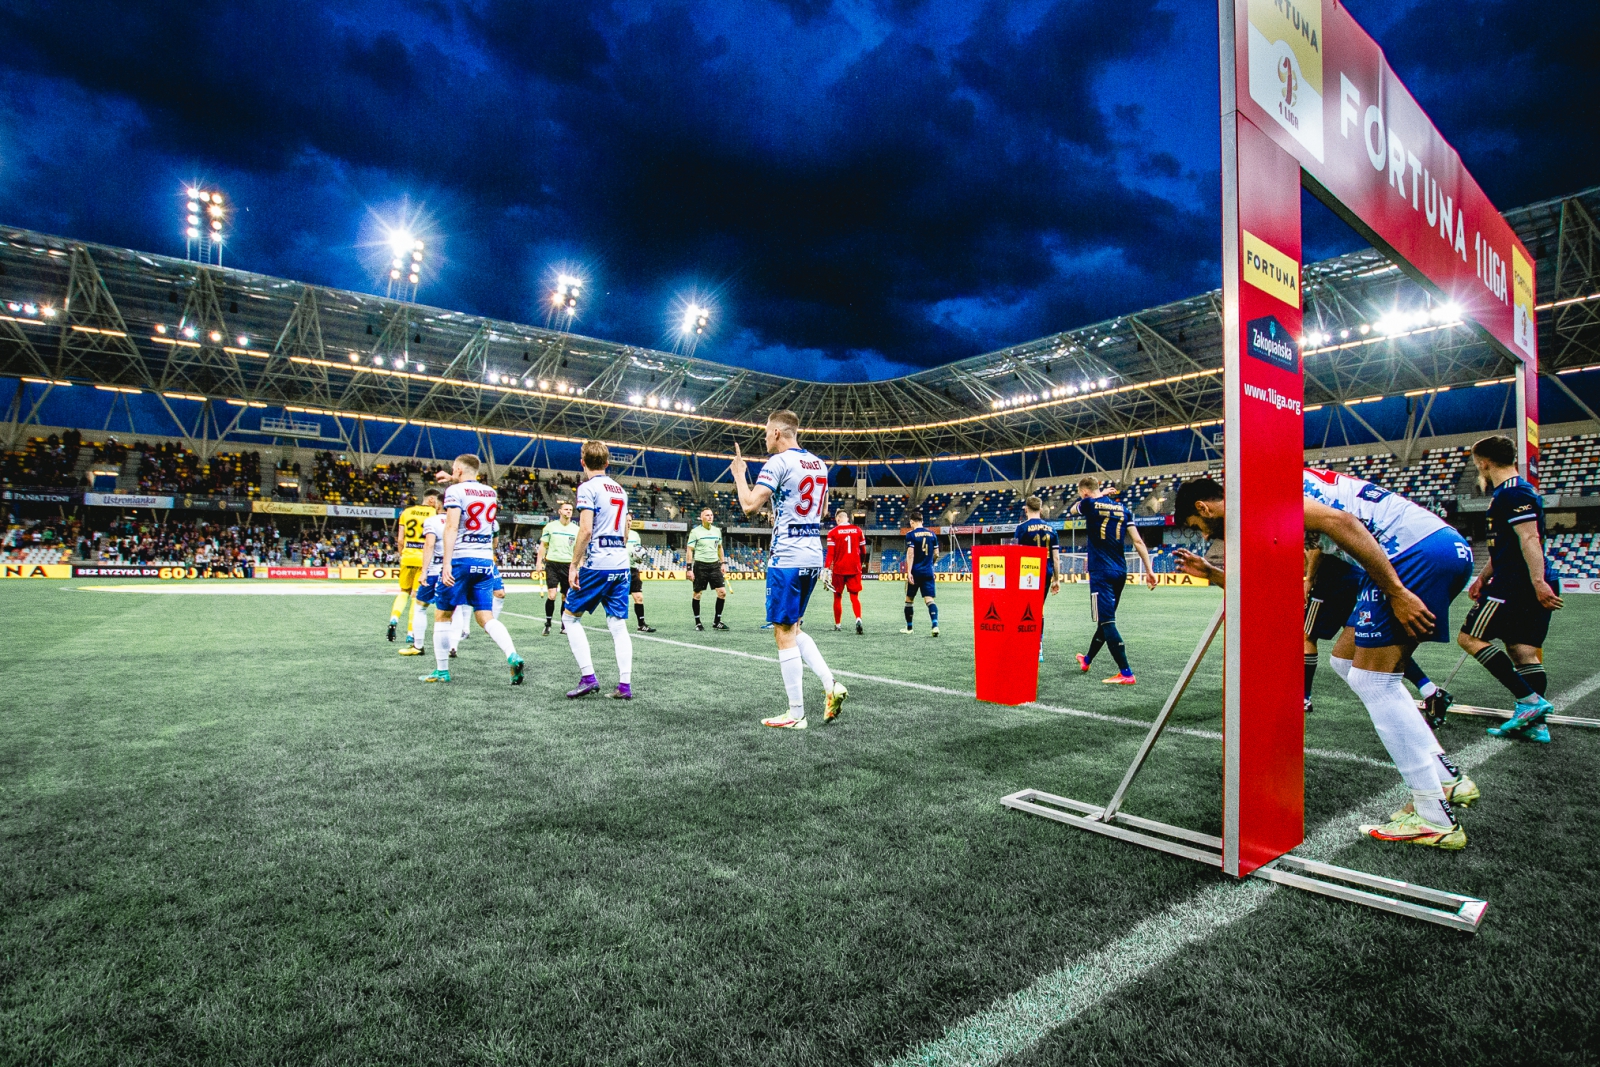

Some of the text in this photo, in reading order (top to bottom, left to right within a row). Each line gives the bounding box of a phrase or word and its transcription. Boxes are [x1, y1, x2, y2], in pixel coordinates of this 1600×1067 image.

[1340, 71, 1467, 262] FORTUNA
[1247, 250, 1296, 290] FORTUNA
[1253, 328, 1292, 361] Zakopiańska
[1244, 382, 1301, 415] www.1liga.org
[14, 493, 69, 502] PANATTONI
[795, 475, 827, 517] 37
[345, 507, 377, 516] TALMET
[610, 497, 625, 532] 7
[1098, 510, 1125, 540] 77
[844, 535, 851, 554] 1
[921, 537, 929, 556] 4
[6, 565, 48, 578] NA
[744, 572, 765, 580] PLN
[879, 573, 893, 581] 600
[981, 623, 1004, 632] SELECT
[1018, 625, 1036, 633] SELECT
